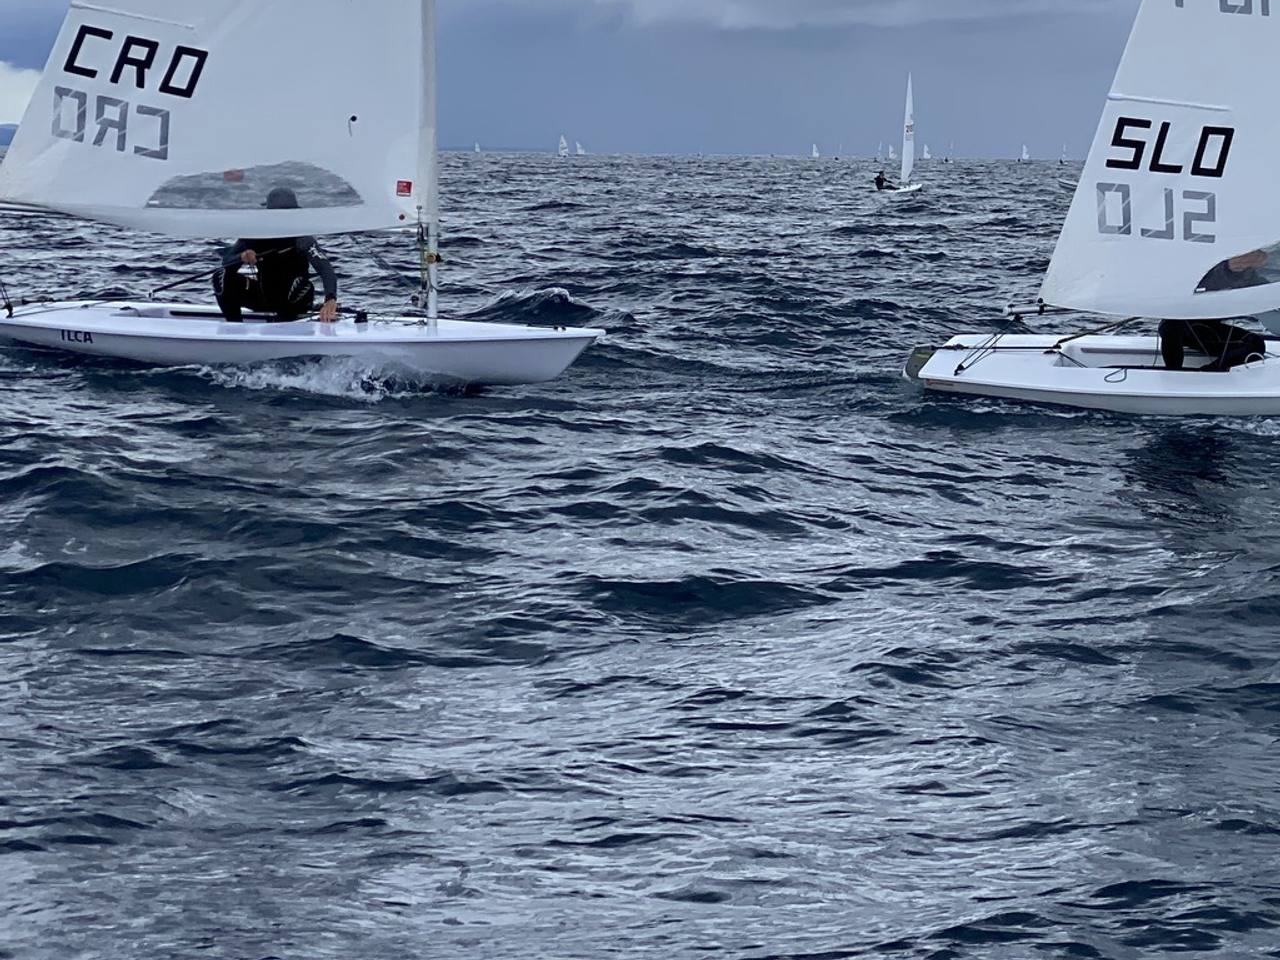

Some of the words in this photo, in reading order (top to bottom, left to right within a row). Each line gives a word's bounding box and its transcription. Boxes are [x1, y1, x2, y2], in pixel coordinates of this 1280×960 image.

[63, 24, 209, 98] CRO
[1105, 116, 1235, 178] SLO
[61, 329, 93, 344] ILCA
